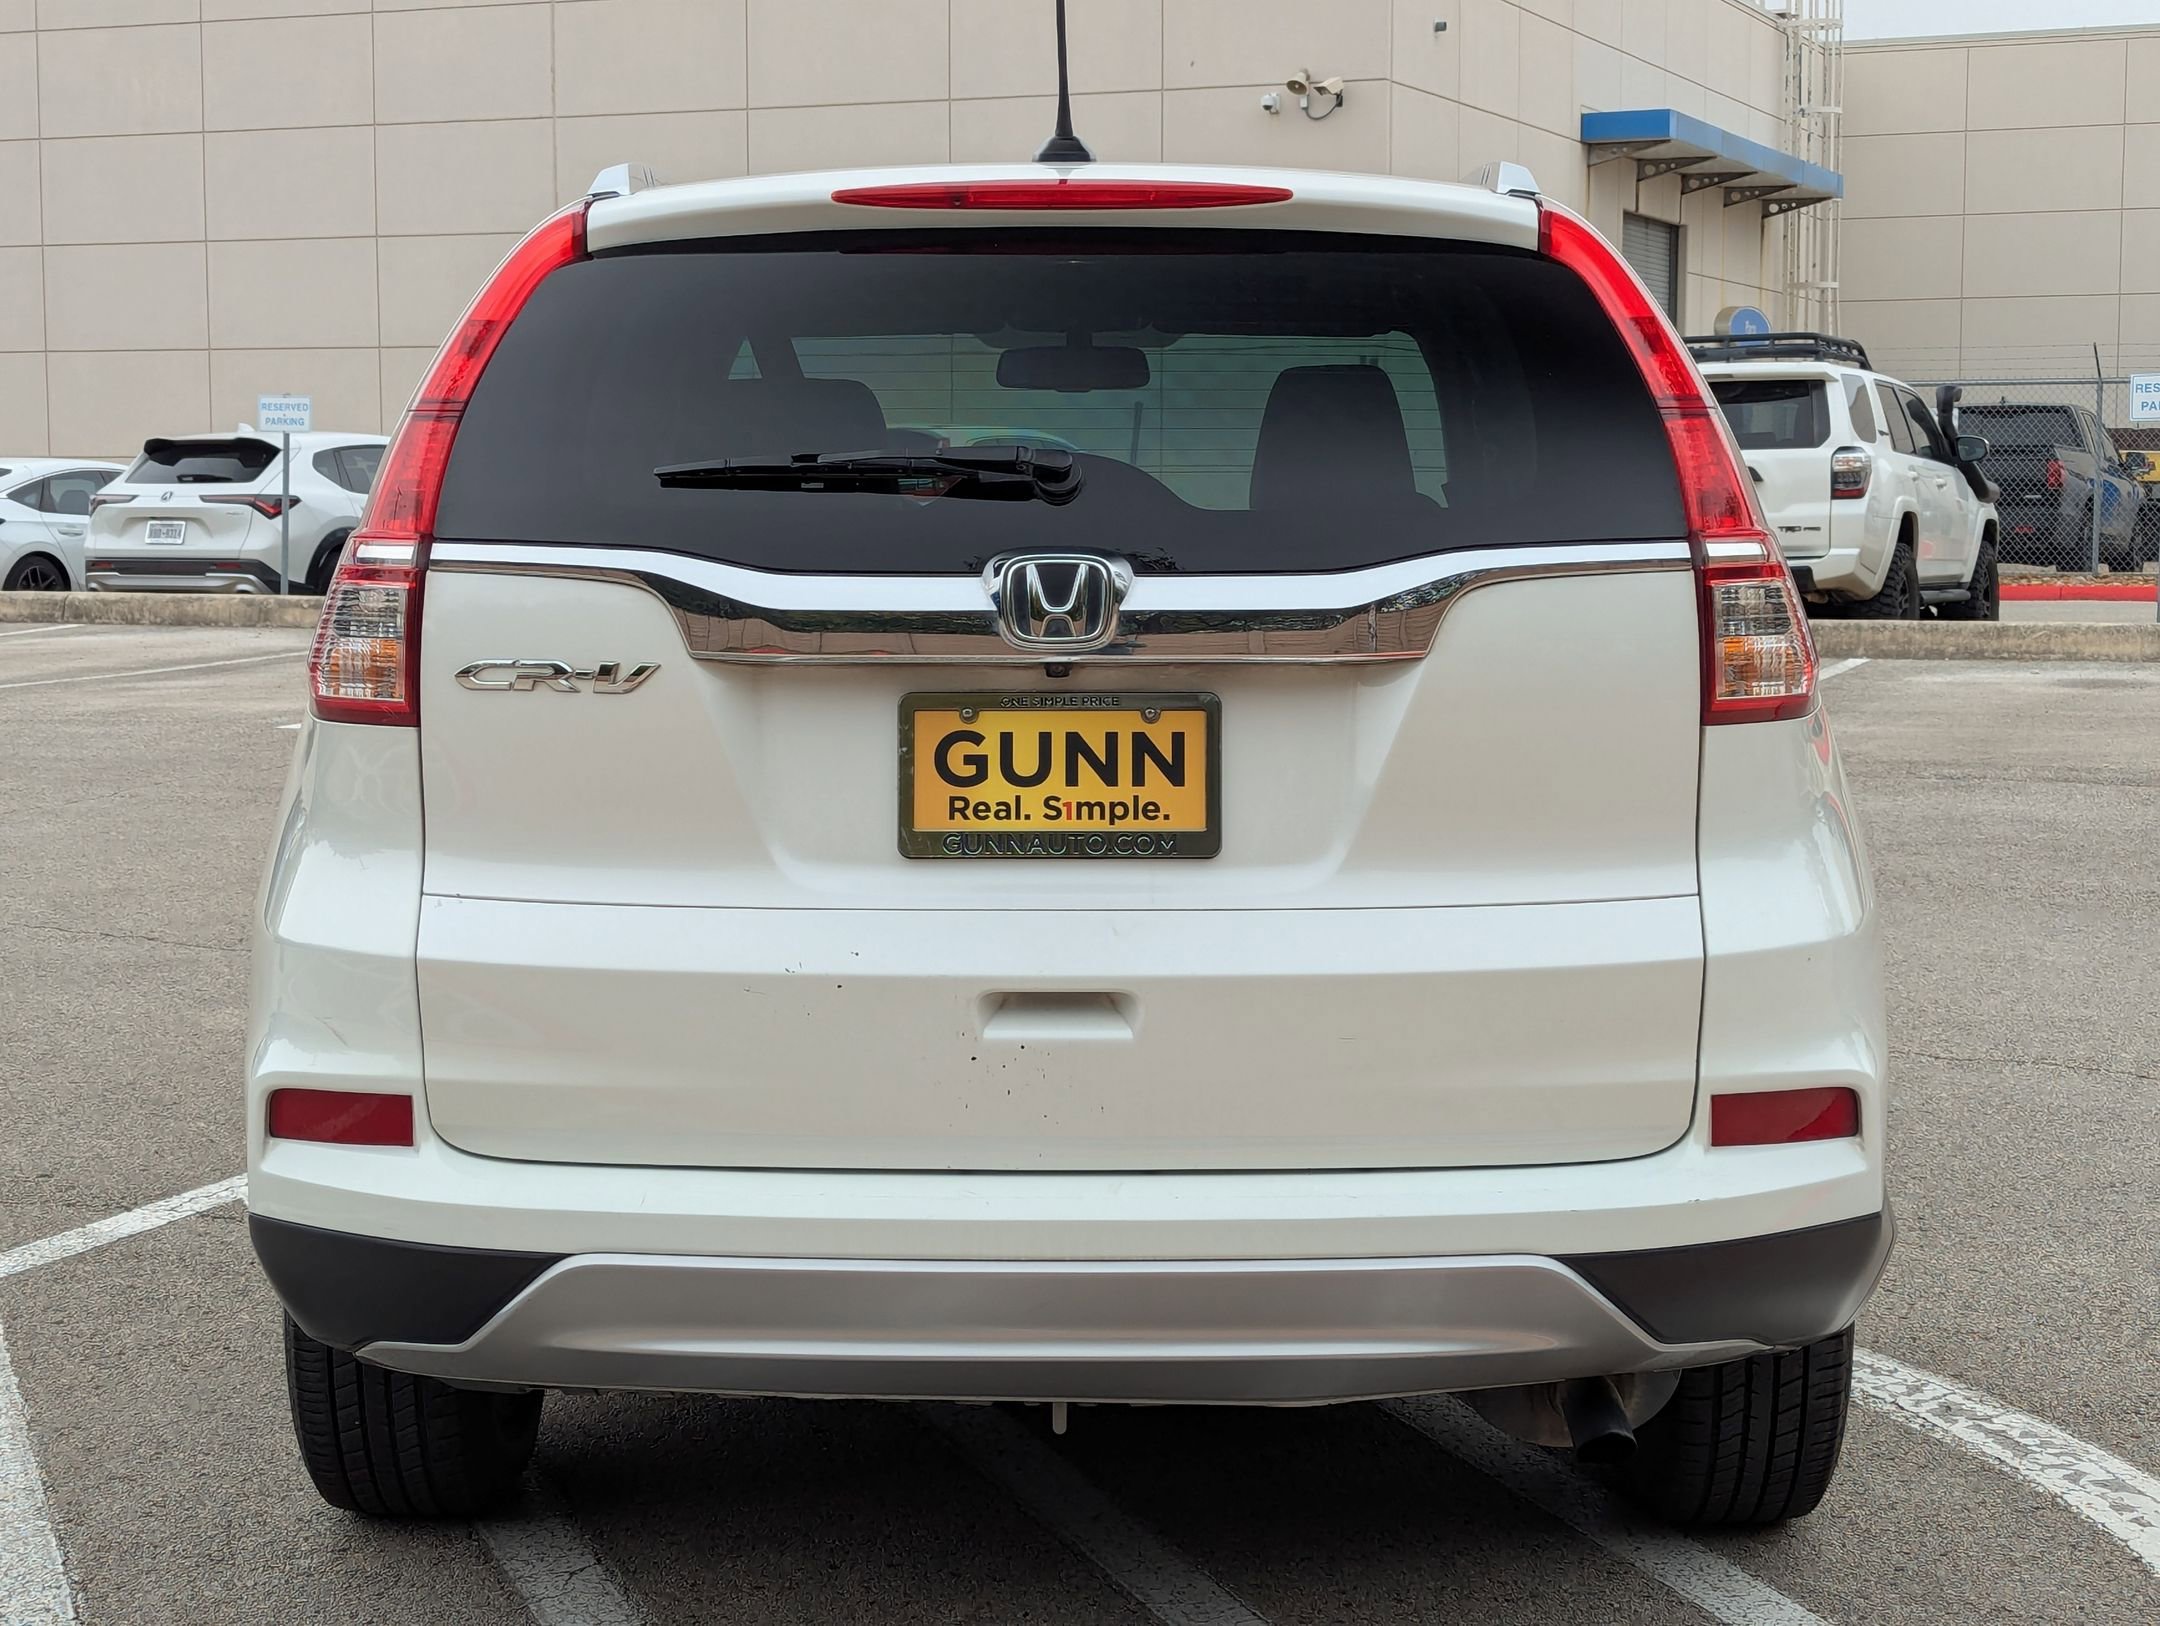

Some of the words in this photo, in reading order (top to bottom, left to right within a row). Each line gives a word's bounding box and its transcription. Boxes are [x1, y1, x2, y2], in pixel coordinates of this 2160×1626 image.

[261, 402, 309, 412] RESERVED
[2141, 401, 2160, 411] PA
[265, 417, 305, 426] PARKING
[454, 659, 661, 694] CR-V
[1000, 696, 1029, 707] ONE
[1031, 696, 1079, 707] SIMPLE
[1081, 696, 1120, 707] PRICE
[934, 729, 1186, 788] GUNN
[948, 795, 1032, 821] Real.
[1042, 795, 1171, 826] S1mple.
[942, 831, 1178, 855] GUNNAUTO.COM
